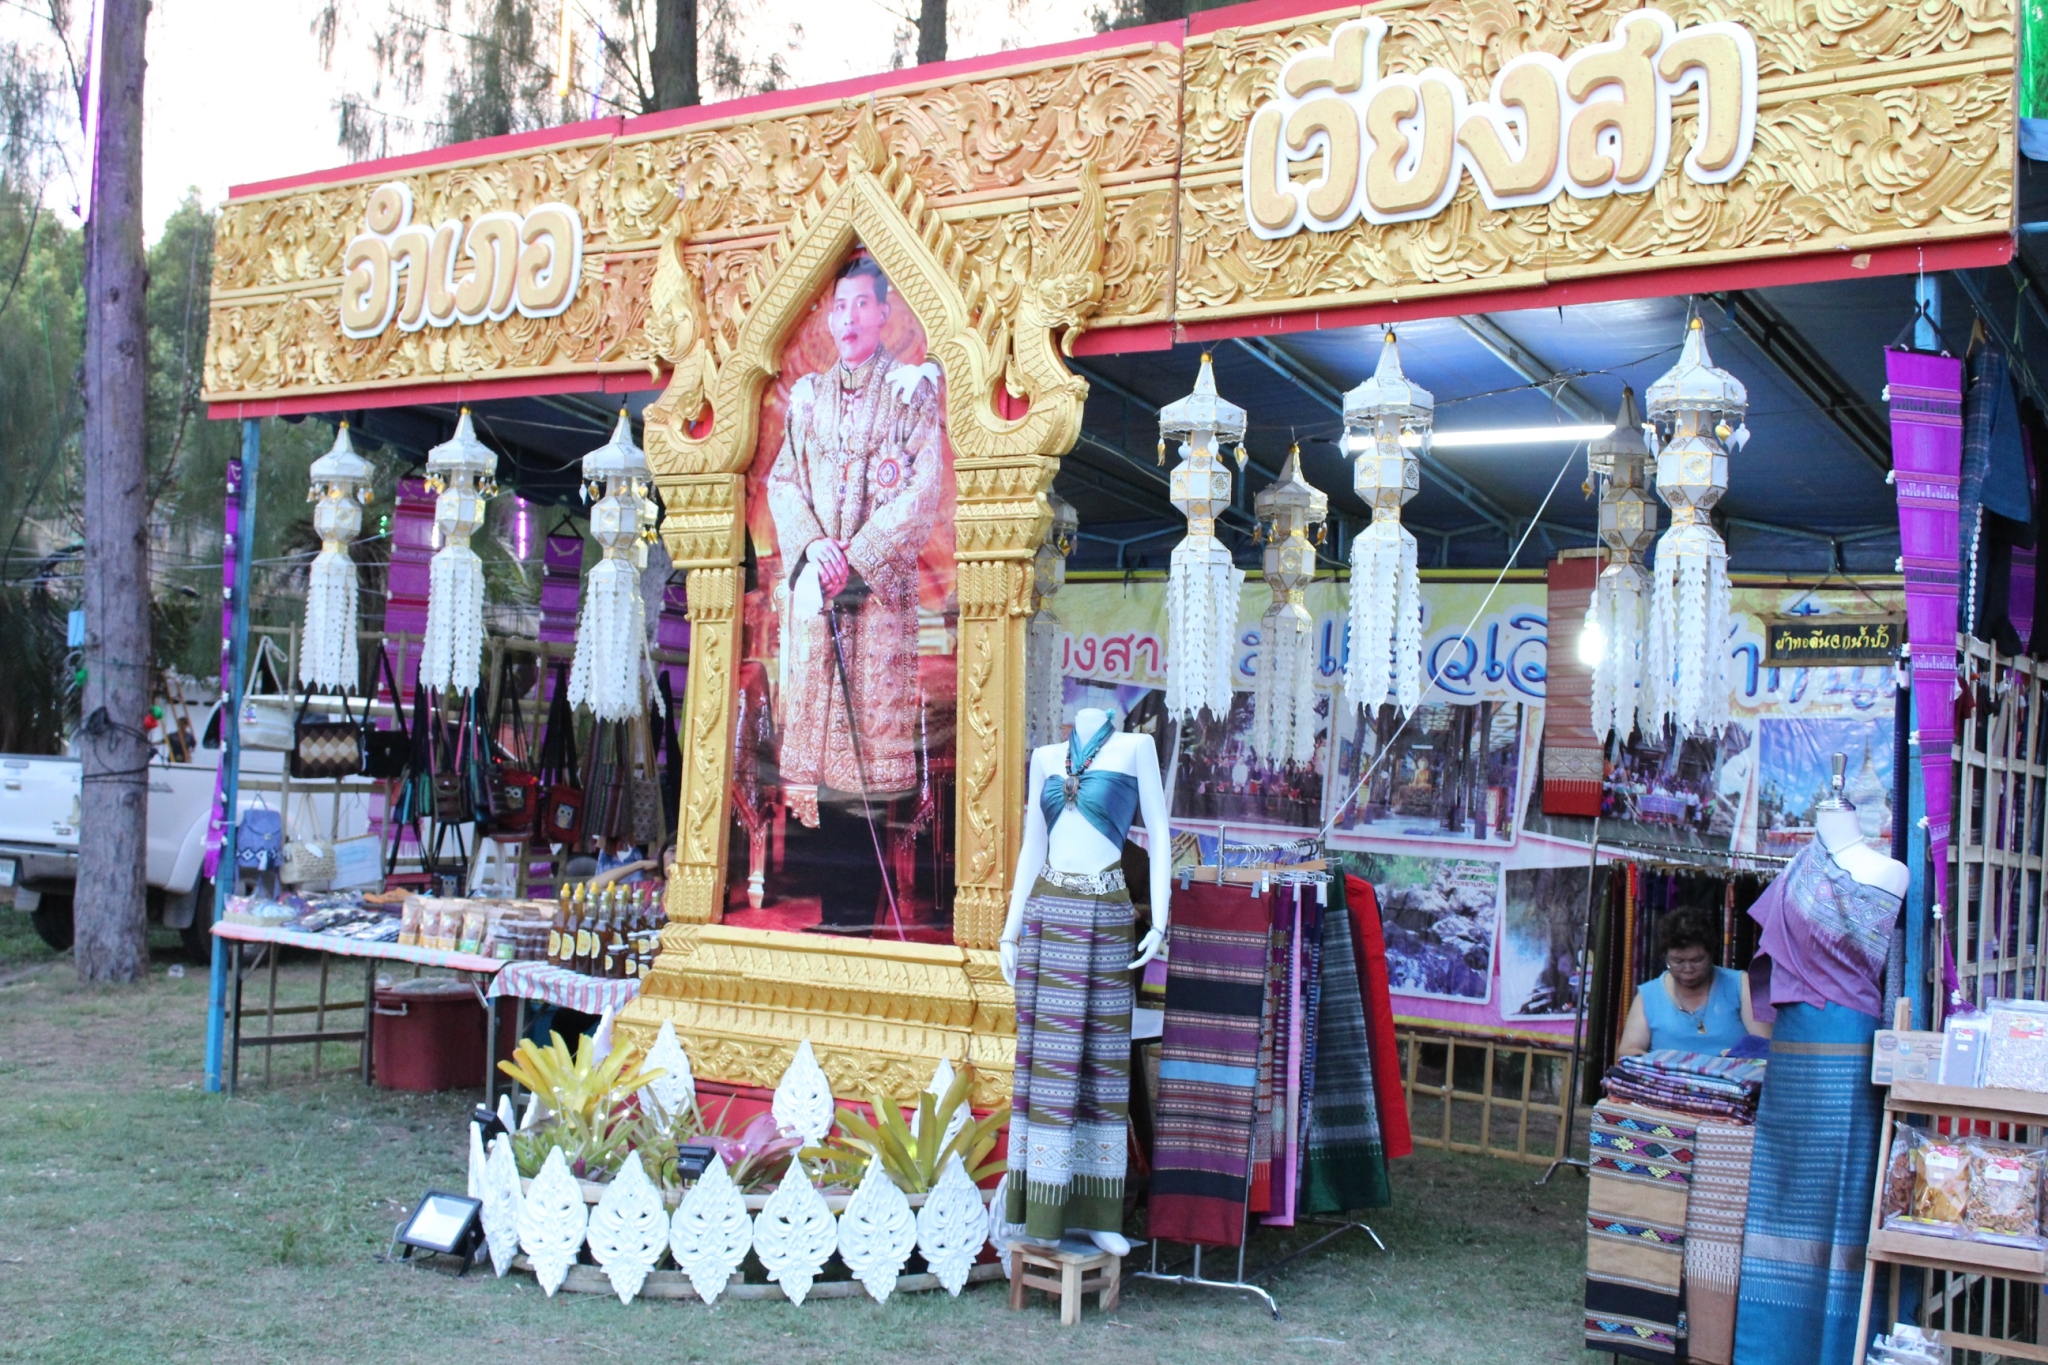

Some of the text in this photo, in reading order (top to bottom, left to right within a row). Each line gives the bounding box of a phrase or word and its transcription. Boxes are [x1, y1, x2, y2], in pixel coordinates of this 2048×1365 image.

[341, 14, 1748, 335] อำเภอ เวียงสา
